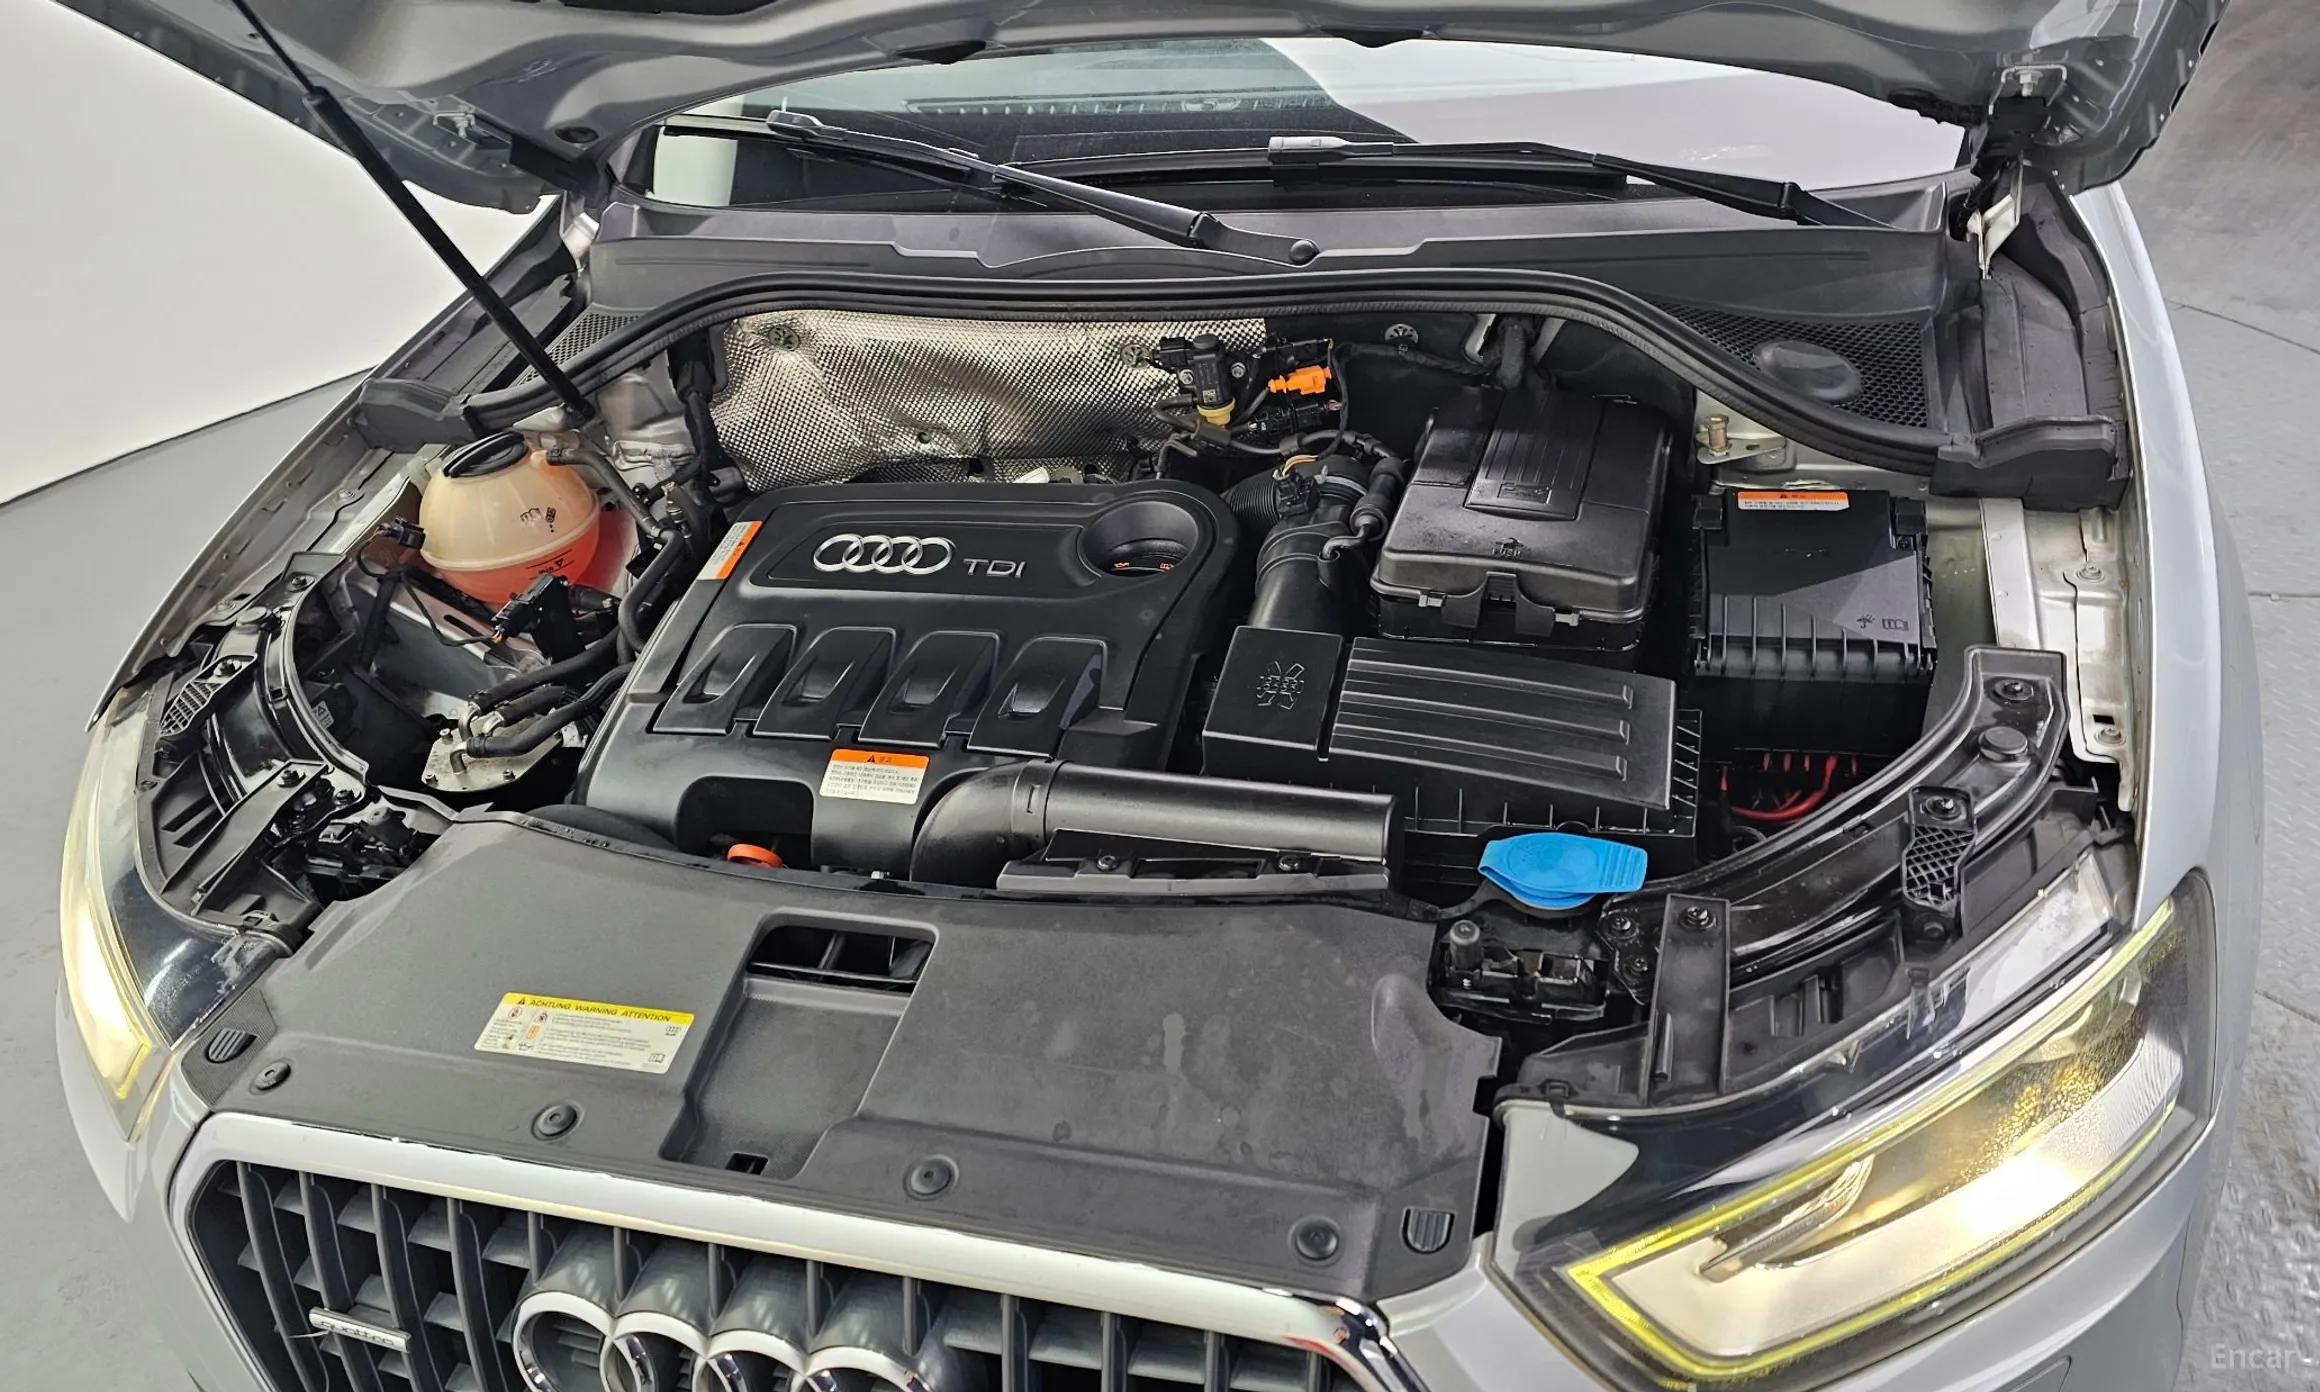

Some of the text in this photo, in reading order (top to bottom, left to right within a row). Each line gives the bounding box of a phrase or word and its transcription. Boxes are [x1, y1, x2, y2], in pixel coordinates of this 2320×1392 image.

[963, 558, 1026, 578] TDI
[529, 999, 672, 1022] ACHTUNG WARNING ATTENTION
